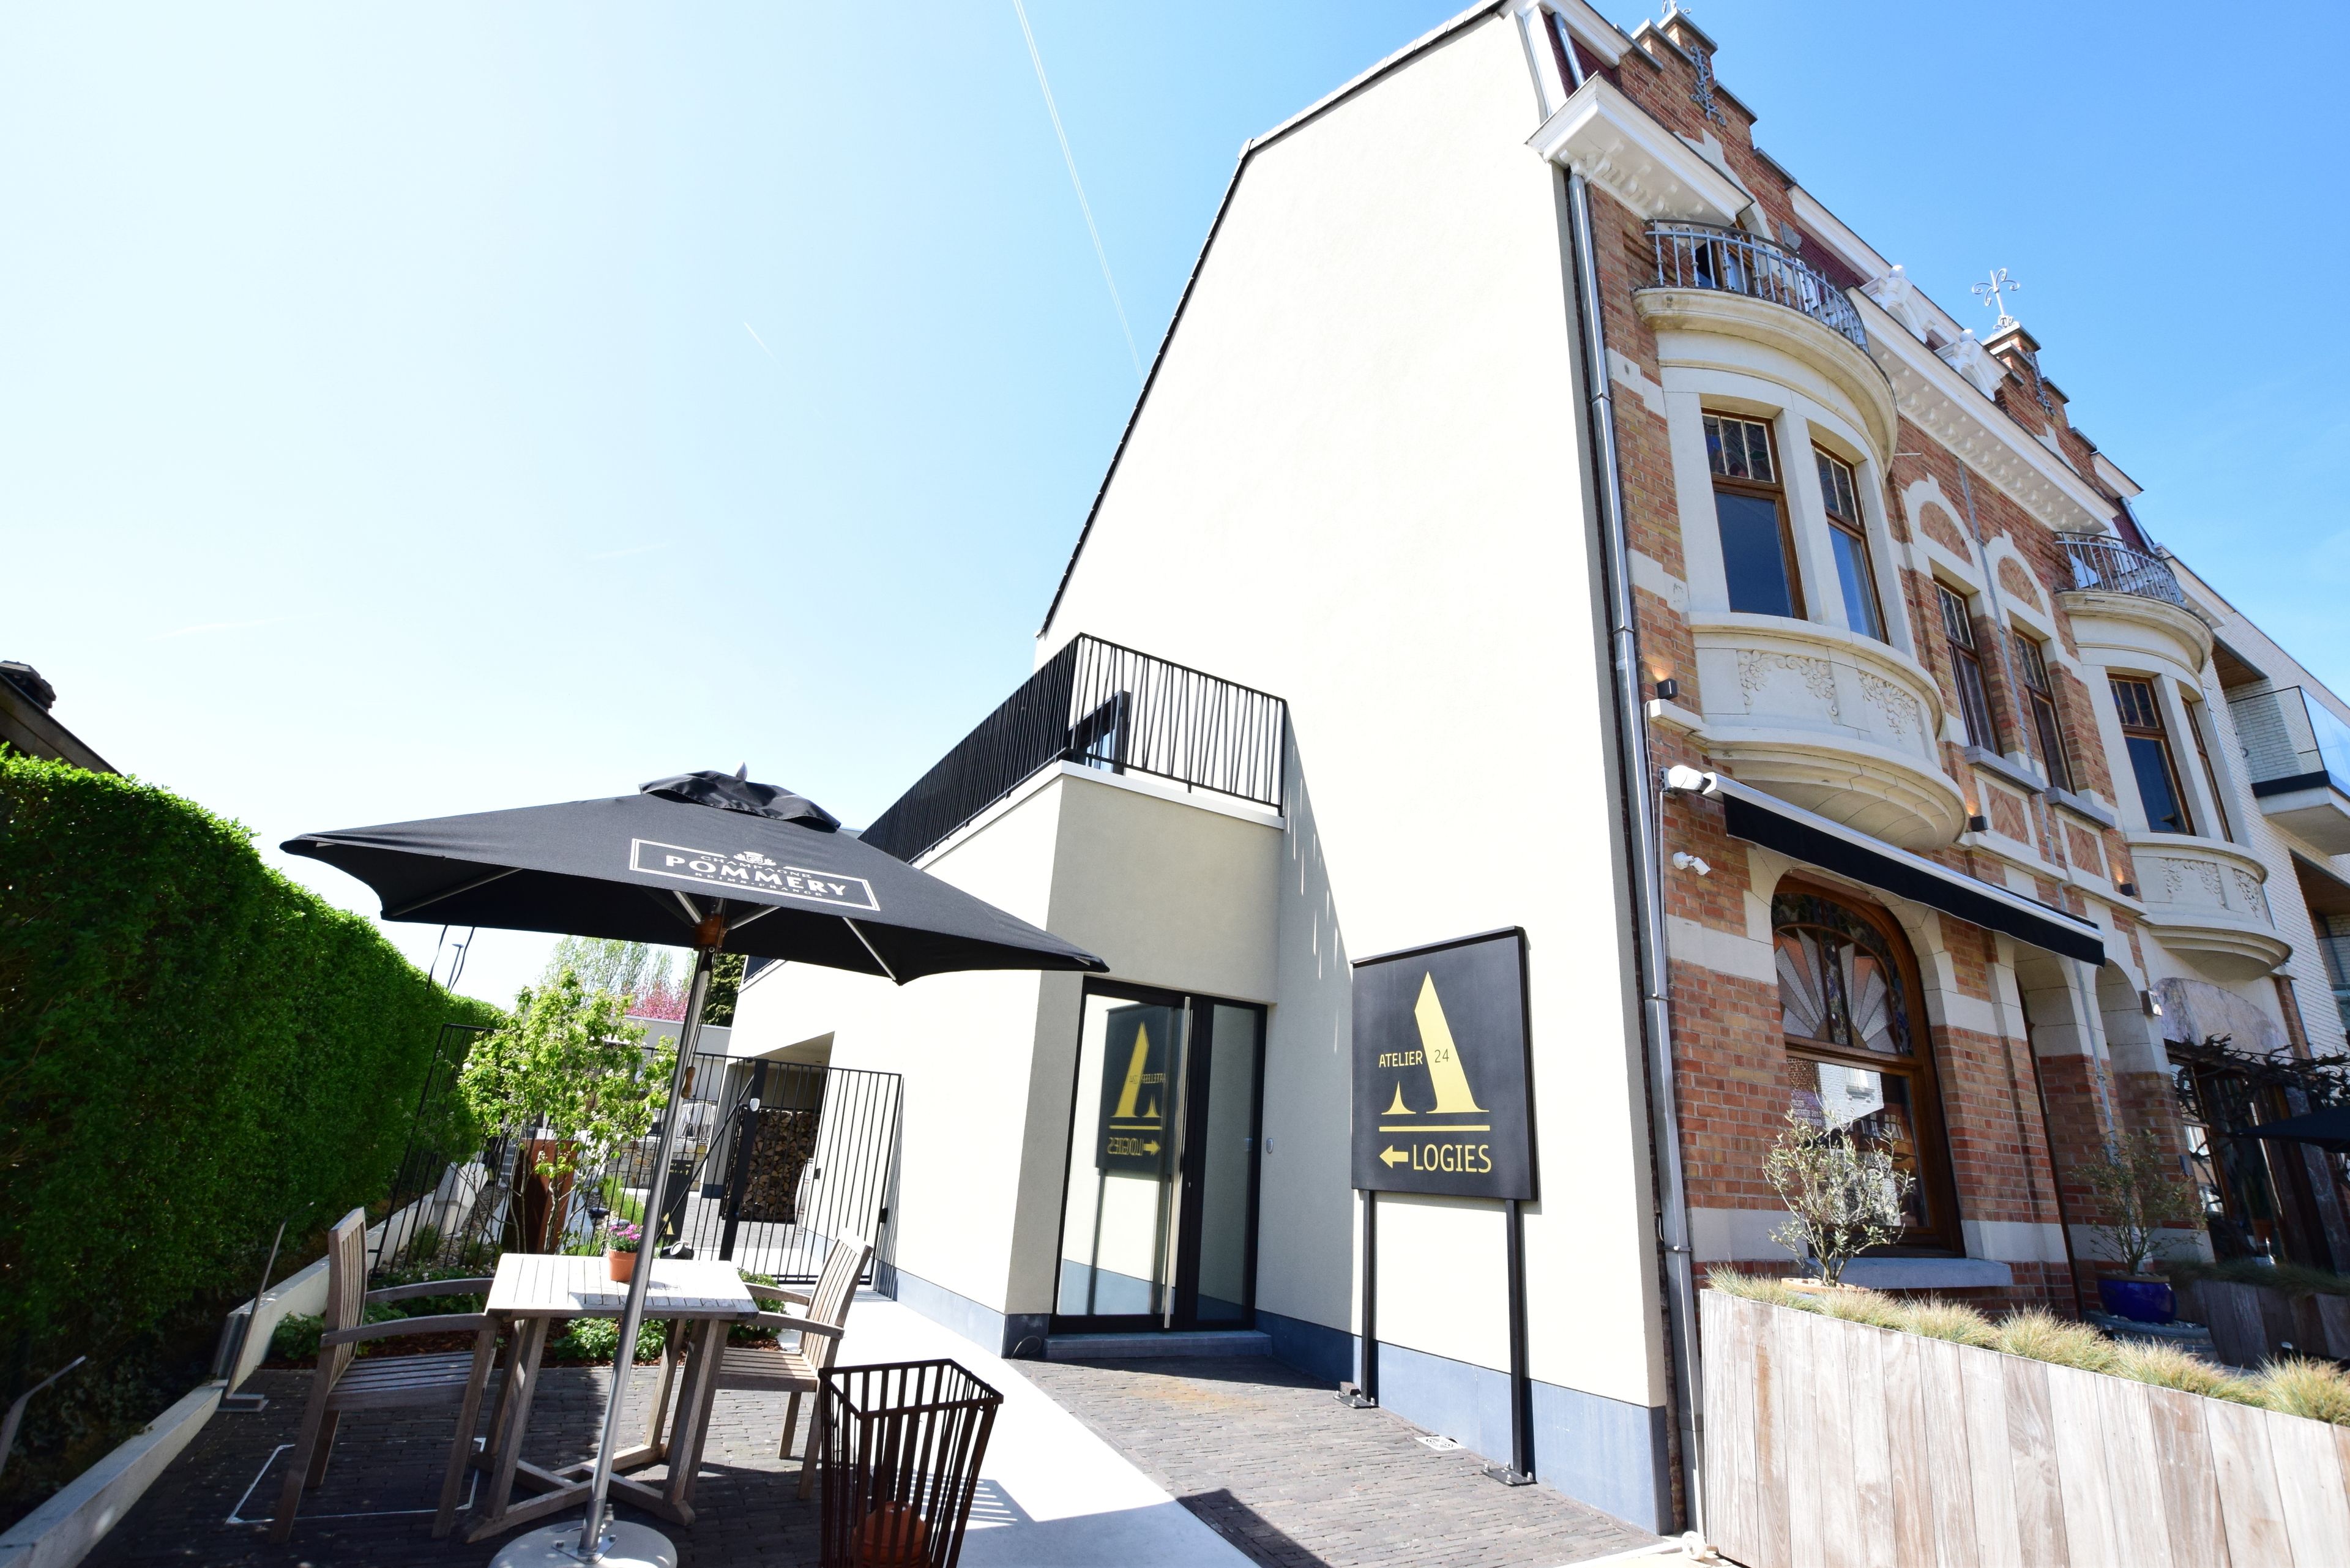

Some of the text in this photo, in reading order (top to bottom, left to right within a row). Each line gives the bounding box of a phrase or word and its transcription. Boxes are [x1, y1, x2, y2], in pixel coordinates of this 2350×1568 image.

[666, 854, 846, 896] POMMERY
[700, 856, 811, 878] CHAMPAGNE
[1379, 1049, 1450, 1069] ATELIER 24
[1413, 1144, 1492, 1174] LOGIES
